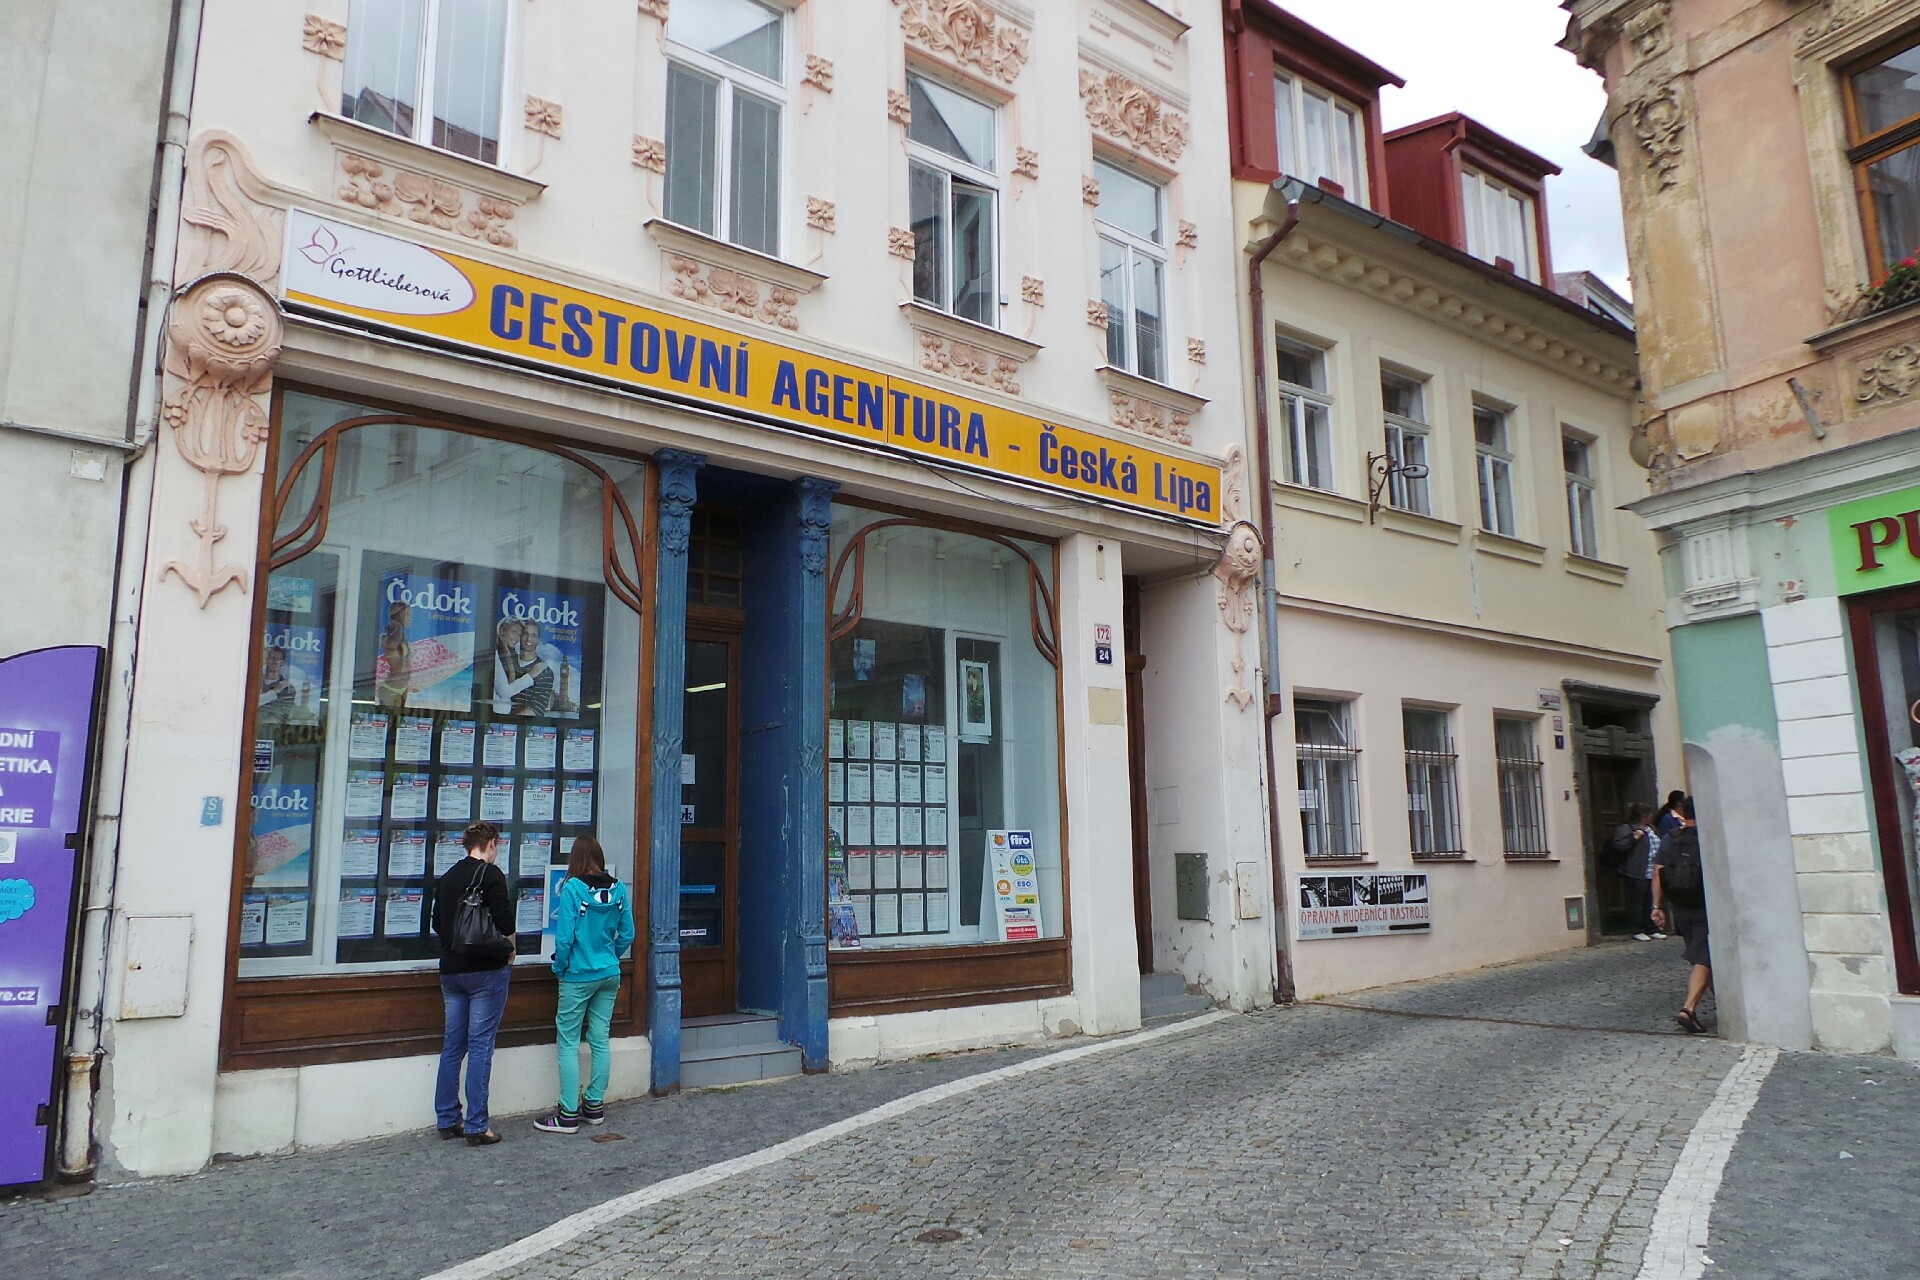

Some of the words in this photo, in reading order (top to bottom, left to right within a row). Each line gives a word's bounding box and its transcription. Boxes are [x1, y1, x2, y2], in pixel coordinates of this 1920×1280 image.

[330, 257, 451, 302] Gottlieberová
[490, 284, 749, 398] CESTOVNÍ
[771, 361, 989, 459] AGENTURA
[1039, 423, 1138, 496] Česká
[1154, 462, 1211, 514] Lípa
[387, 577, 472, 615] Čedok
[502, 592, 579, 627] Čedok
[263, 629, 320, 652] edok
[1096, 627, 1110, 641] 172
[1099, 649, 1110, 661] 24
[250, 788, 309, 811] edok
[1009, 834, 1030, 846] firo
[1300, 909, 1340, 925] OPRAVNA
[1343, 903, 1388, 922] HUDEBNÍCH
[1390, 901, 1429, 920] NÁSTROJŮ
